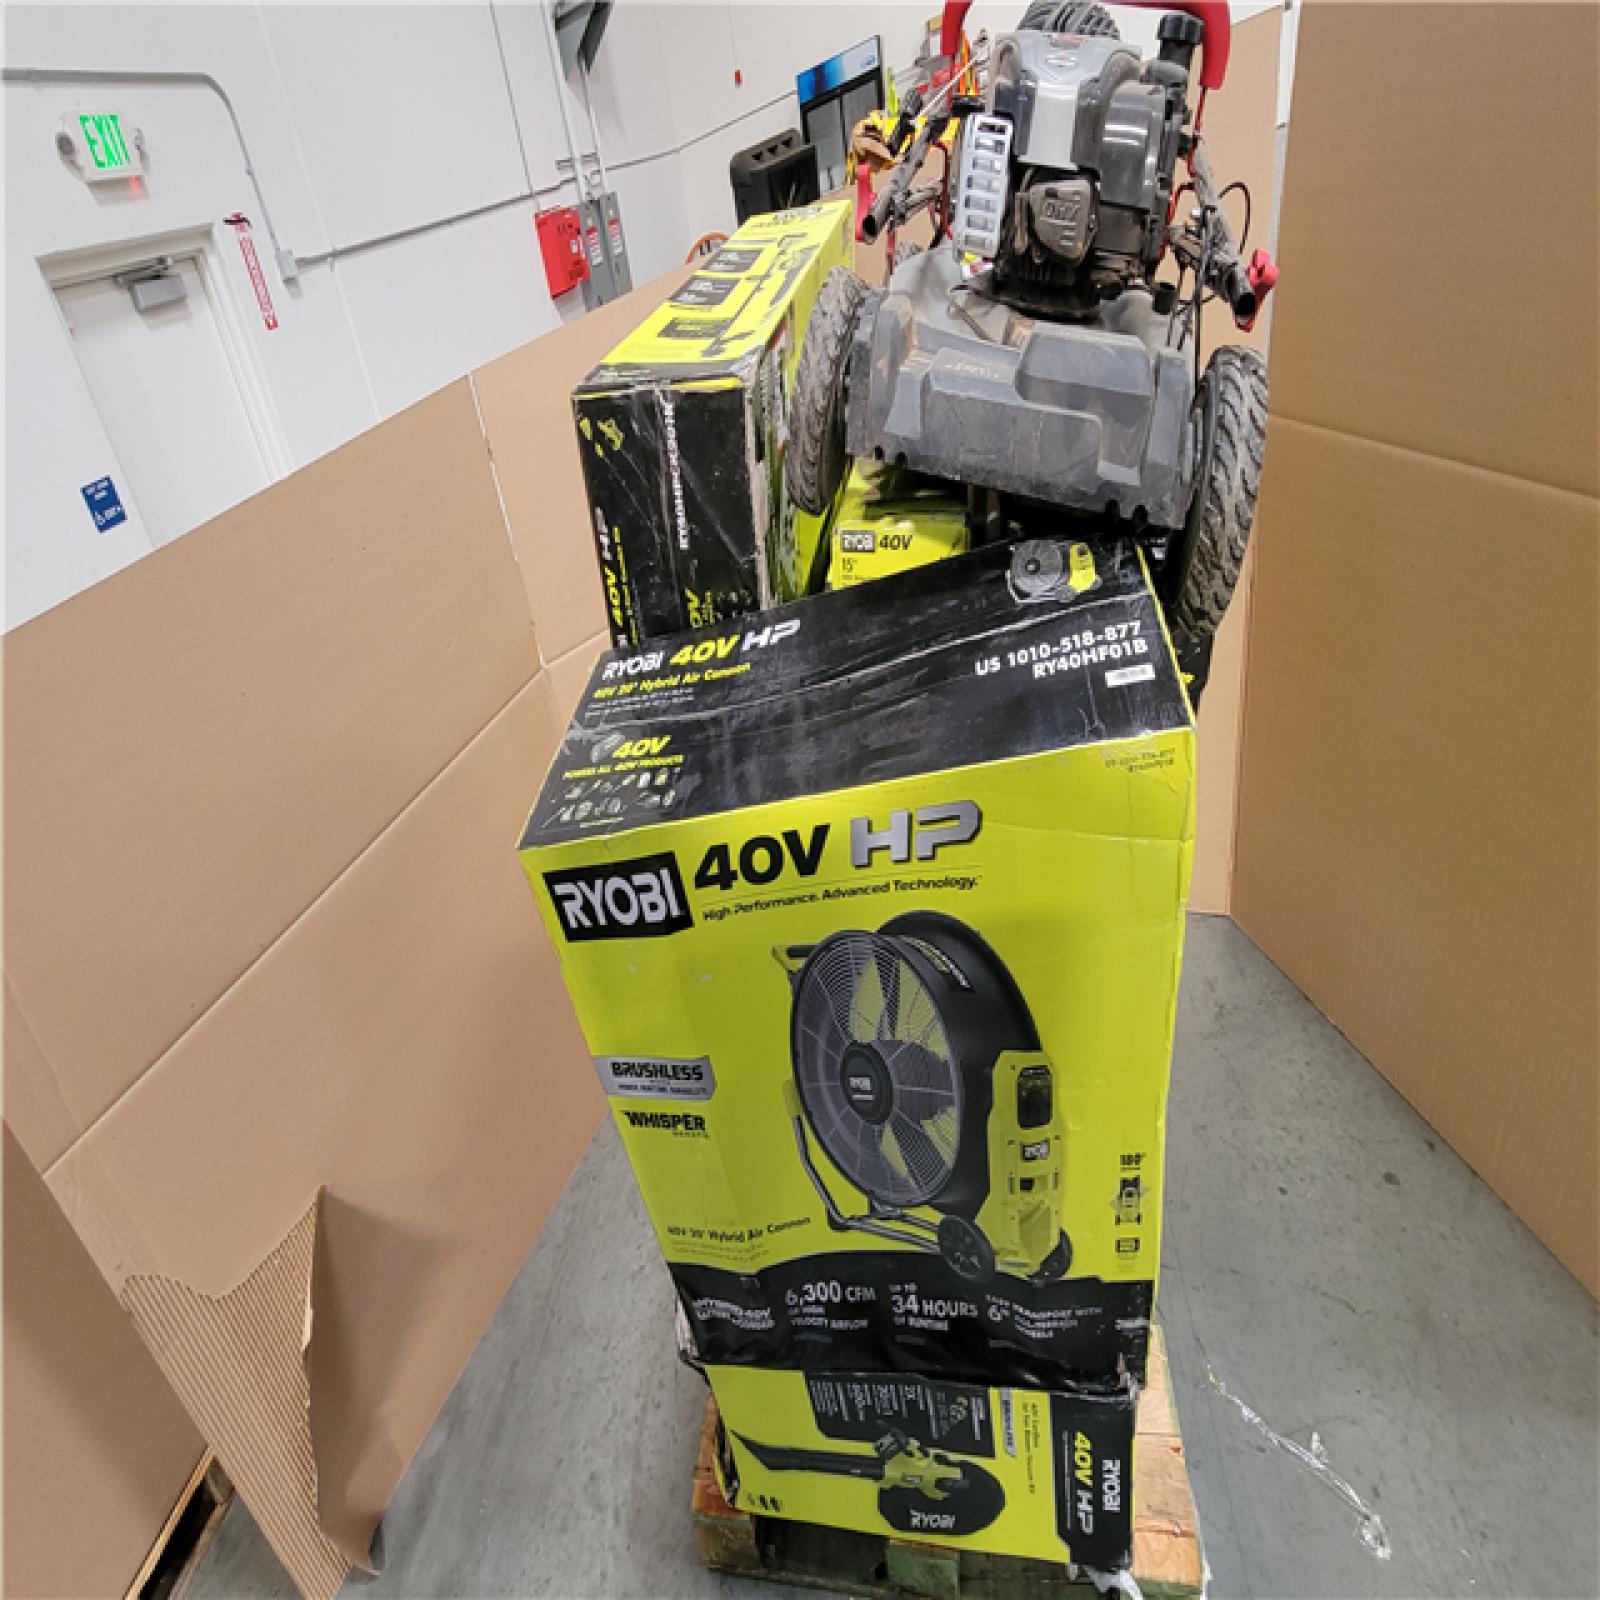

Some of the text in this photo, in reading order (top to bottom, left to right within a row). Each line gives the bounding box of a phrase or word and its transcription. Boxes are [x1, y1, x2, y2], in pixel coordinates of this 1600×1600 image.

[80, 114, 131, 168] EXIT
[595, 506, 613, 561] HP
[880, 534, 913, 551] 40V
[604, 565, 624, 627] 40V
[602, 619, 801, 680] RYOBI 40V HP
[975, 620, 1141, 676] US 1010-518-877
[1032, 639, 1149, 679] RY40HF01B
[640, 675, 681, 692] Hybrid
[682, 671, 701, 685] Air
[704, 662, 751, 681] Cannon
[612, 735, 672, 759] 40V
[552, 799, 982, 929] RYOBI 40V HP
[703, 906, 732, 921] High
[822, 881, 892, 902] Advanced
[610, 1062, 704, 1081] BRUSHLESS
[621, 1110, 706, 1131] WHISPER
[709, 1231, 746, 1243] Hybrid
[747, 1229, 764, 1241] Air
[767, 1217, 812, 1233] Cannon
[785, 1280, 877, 1307] 6,300 CFM
[891, 1294, 979, 1318] 34 HOURS
[1074, 1431, 1094, 1535] 40V HP
[1102, 1459, 1120, 1513] RYOBI
[909, 1509, 956, 1530] RYOBI
